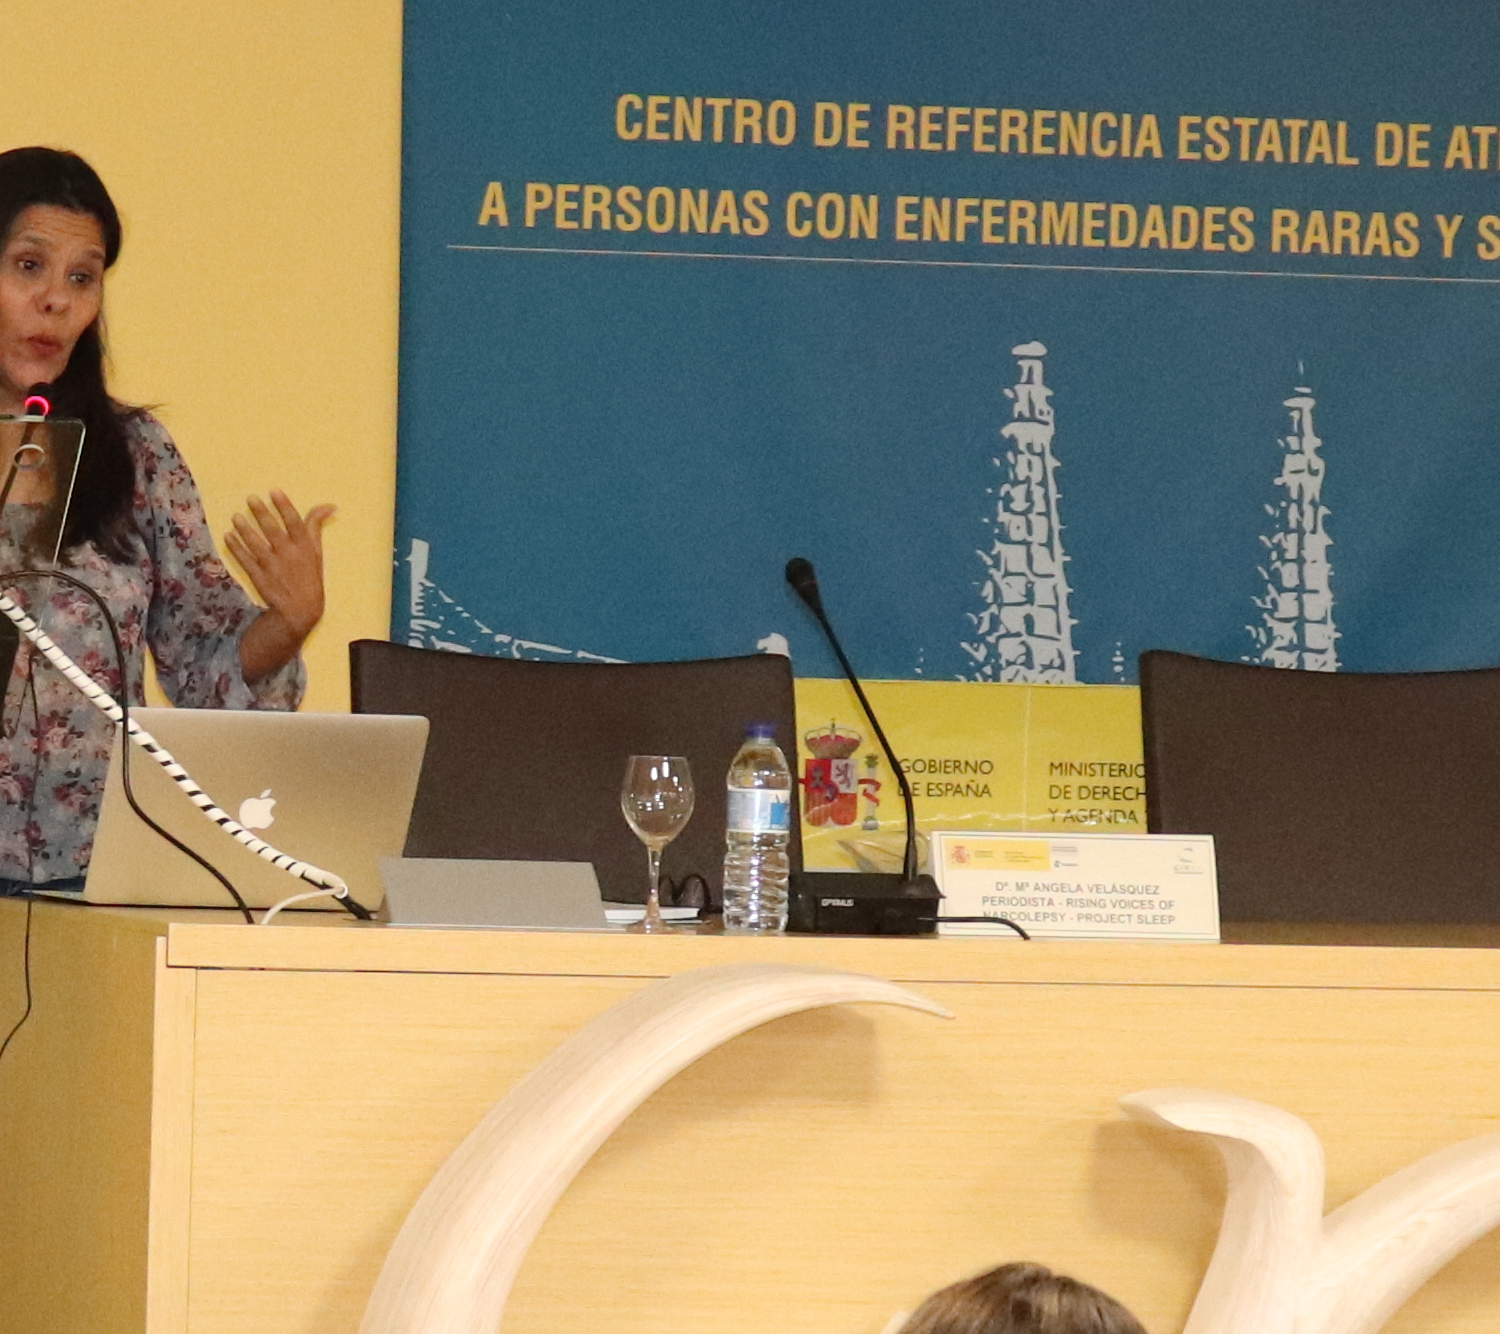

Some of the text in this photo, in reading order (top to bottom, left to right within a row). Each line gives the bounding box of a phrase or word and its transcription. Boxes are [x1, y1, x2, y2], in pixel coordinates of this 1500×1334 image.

[614, 93, 797, 148] CENTRO
[813, 101, 872, 151] DE
[886, 104, 1162, 158] REFERENCIA
[1177, 117, 1360, 165] ESTATAL
[1374, 121, 1430, 169] DE
[479, 182, 508, 227] A
[524, 182, 769, 236] PERSONAS
[785, 193, 878, 241] CON
[895, 197, 1255, 252] ENFERMEDADES
[1271, 210, 1420, 257] RARAS
[1435, 216, 1461, 259] Y
[900, 758, 994, 774] GOBIERNO
[1050, 762, 1145, 778] MINISTERIO
[927, 780, 991, 798] ESPAÑA
[1050, 785, 1147, 800] DE DERECH
[1048, 808, 1138, 824] Y AGENDA
[1034, 883, 1082, 893] ANGELA
[982, 896, 1054, 907] PERIODISTA
[1066, 898, 1106, 909] RISING
[1112, 900, 1154, 910] VOICES
[1159, 900, 1174, 910] OF
[1077, 913, 1133, 924] PROJECT
[1137, 915, 1175, 925] SLEEP
